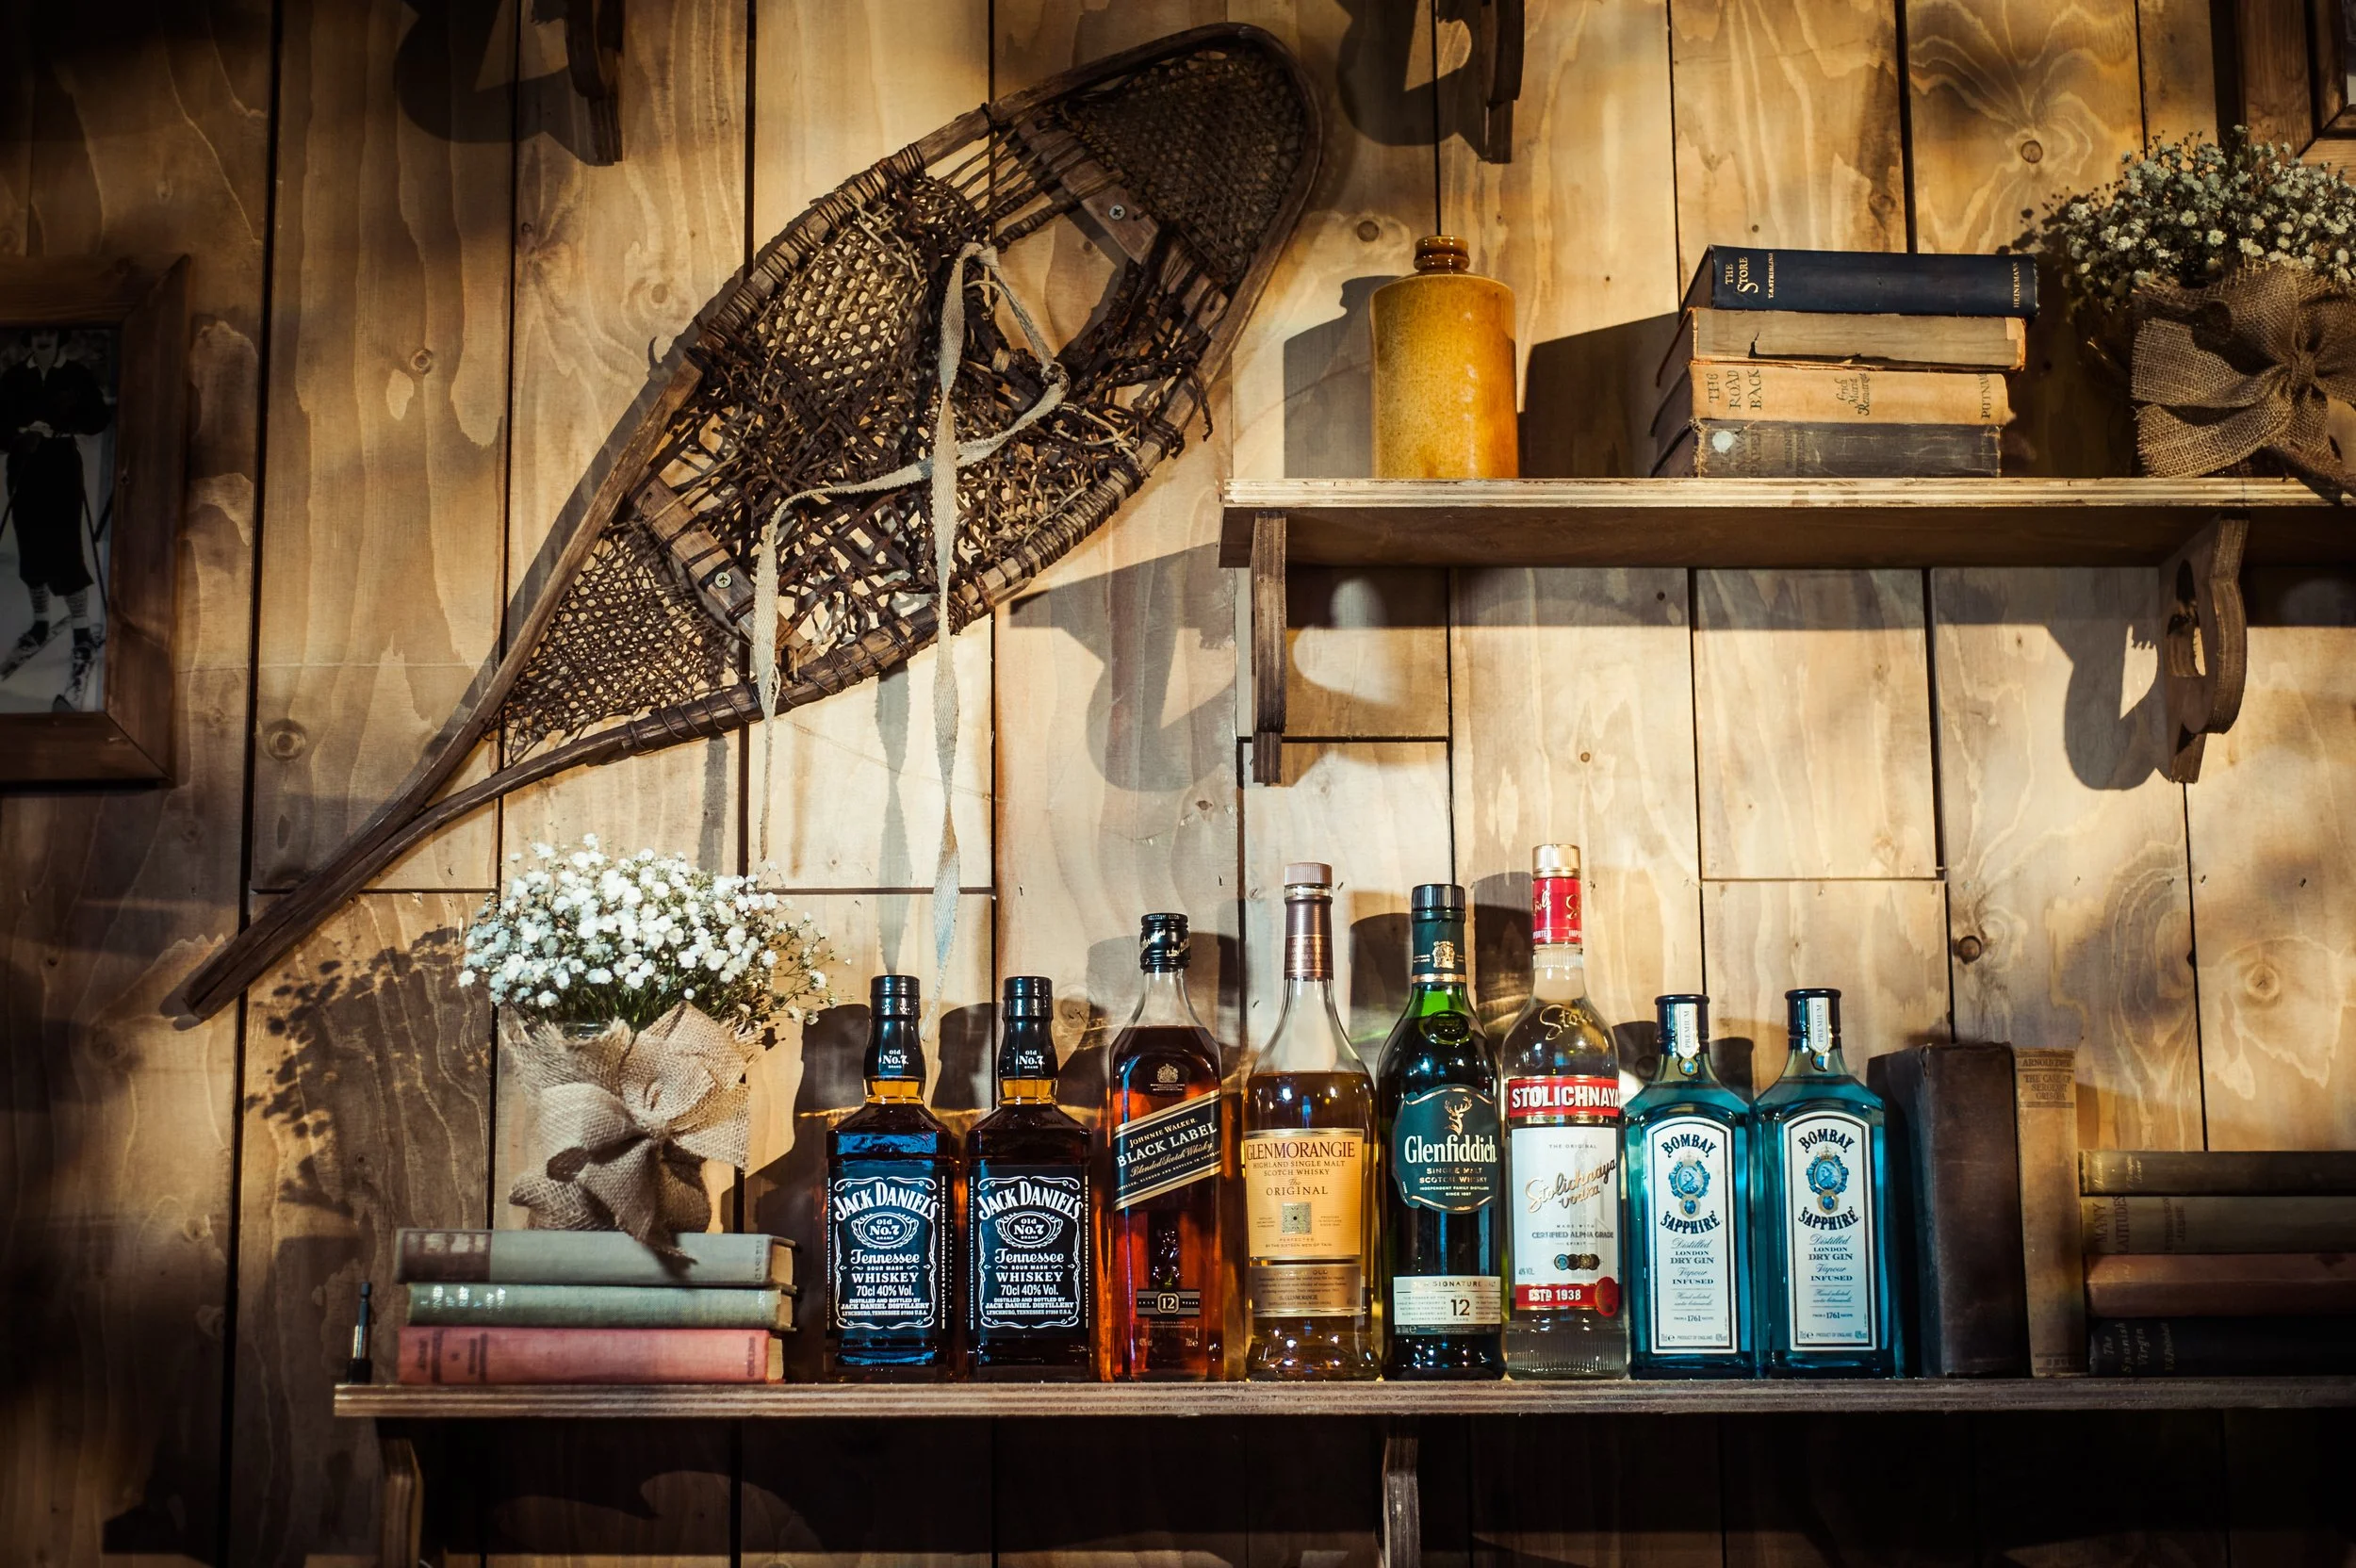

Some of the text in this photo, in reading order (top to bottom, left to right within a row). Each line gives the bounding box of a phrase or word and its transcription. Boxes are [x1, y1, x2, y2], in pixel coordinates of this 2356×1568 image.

[1725, 263, 1734, 285] THE
[1737, 256, 1759, 294] STORE
[1709, 372, 1720, 403] THE
[1728, 369, 1742, 410] ROAD
[1749, 368, 1762, 411] BACK
[1116, 1122, 1218, 1168] BLACK LABEL
[1129, 1118, 1197, 1148] JOHNNIE WALKER
[1798, 1128, 1855, 1153] BOMBAY
[1247, 1141, 1355, 1160] GLENMORANGIE
[1404, 1135, 1496, 1164] Glenfiddich
[1661, 1134, 1717, 1158] BOMBAY
[1129, 1140, 1214, 1178] Blended Scotch Whisky
[1252, 1160, 1288, 1168] HIGHLAND
[1266, 1186, 1329, 1196] ORIGINAL
[1525, 1158, 1616, 1214] Stolichnaya
[833, 1182, 941, 1221] JACK DANIEL'S
[976, 1181, 1084, 1220] JACK DANIEL'S
[1013, 1224, 1045, 1235] No.7
[1661, 1210, 1721, 1234] SAPPHIRE
[1798, 1205, 1859, 1230] SAPPHIRE
[2093, 1202, 2108, 1243] MANY
[2112, 1195, 2130, 1253] LATITUDES
[869, 1225, 900, 1235] No.7
[1531, 1231, 1569, 1239] CERTIFIED
[1809, 1233, 1852, 1246] Distilled
[850, 1249, 921, 1264] Tennessee
[994, 1248, 1065, 1264] Tennessee
[851, 1272, 919, 1283] WHISKEY
[995, 1271, 1063, 1282] WHISKEY
[856, 1284, 914, 1297] 70cl 40% Vol.
[1000, 1284, 1059, 1296] 70cl 40% Vol.
[1556, 1288, 1581, 1301] 1938
[1162, 1298, 1175, 1309] 12
[1450, 1298, 1470, 1316] 12
[2102, 1335, 2115, 1355] The
[2115, 1322, 2135, 1373] Spanish
[2136, 1328, 2151, 1365] Virgin
